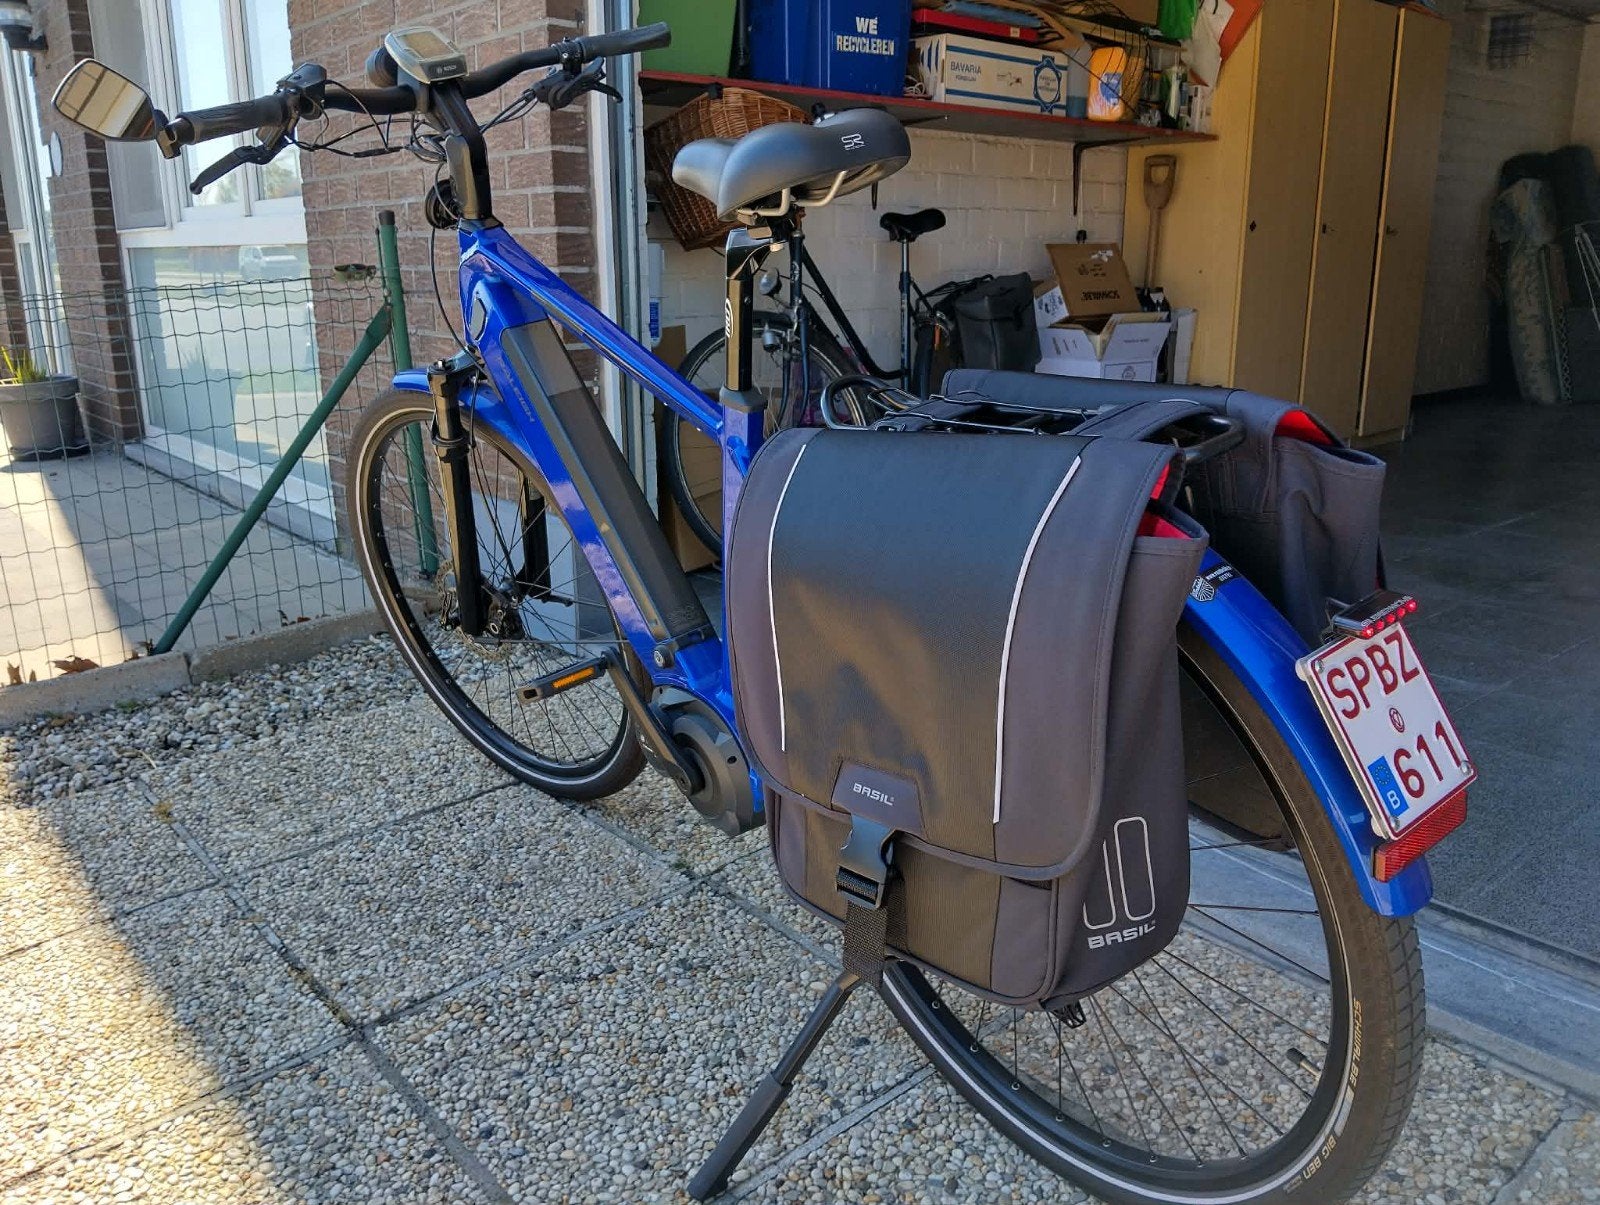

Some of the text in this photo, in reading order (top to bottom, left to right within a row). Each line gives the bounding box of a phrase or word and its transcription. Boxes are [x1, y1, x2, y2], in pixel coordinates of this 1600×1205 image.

[836, 34, 895, 56] RECYCLEREN
[950, 60, 982, 75] BAVARIA
[1326, 629, 1420, 719] SPBZ
[1393, 720, 1461, 798] 611
[852, 782, 894, 806] BASIL
[1386, 789, 1401, 809] B
[1087, 923, 1156, 950] BASIL
[1349, 999, 1363, 1088] SCHWALBE
[1302, 1134, 1337, 1180] BIG BEN
